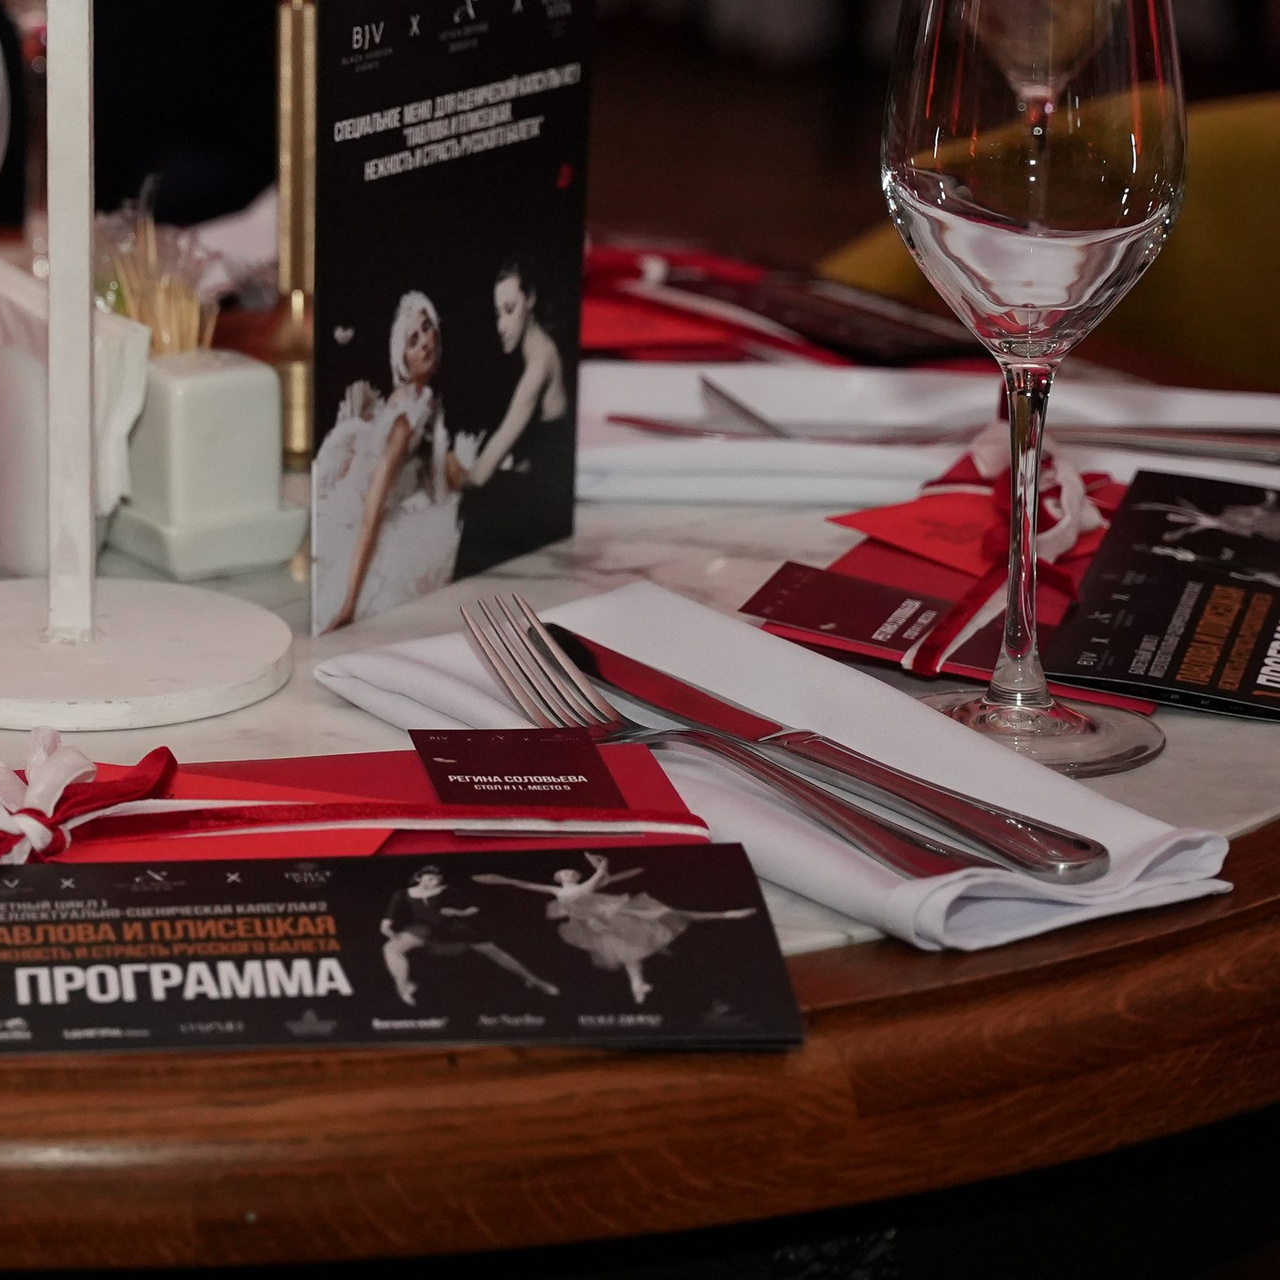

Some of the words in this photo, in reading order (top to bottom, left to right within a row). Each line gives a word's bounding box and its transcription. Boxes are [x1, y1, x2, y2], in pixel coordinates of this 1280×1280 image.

[447, 775, 503, 783] РЕГИНА
[503, 775, 588, 783] СОЛОВЬЕВА
[122, 920, 145, 942] И
[150, 915, 338, 941] ПЛИСЕЦКАЯ
[14, 957, 354, 1006] ПРОГРАММА
